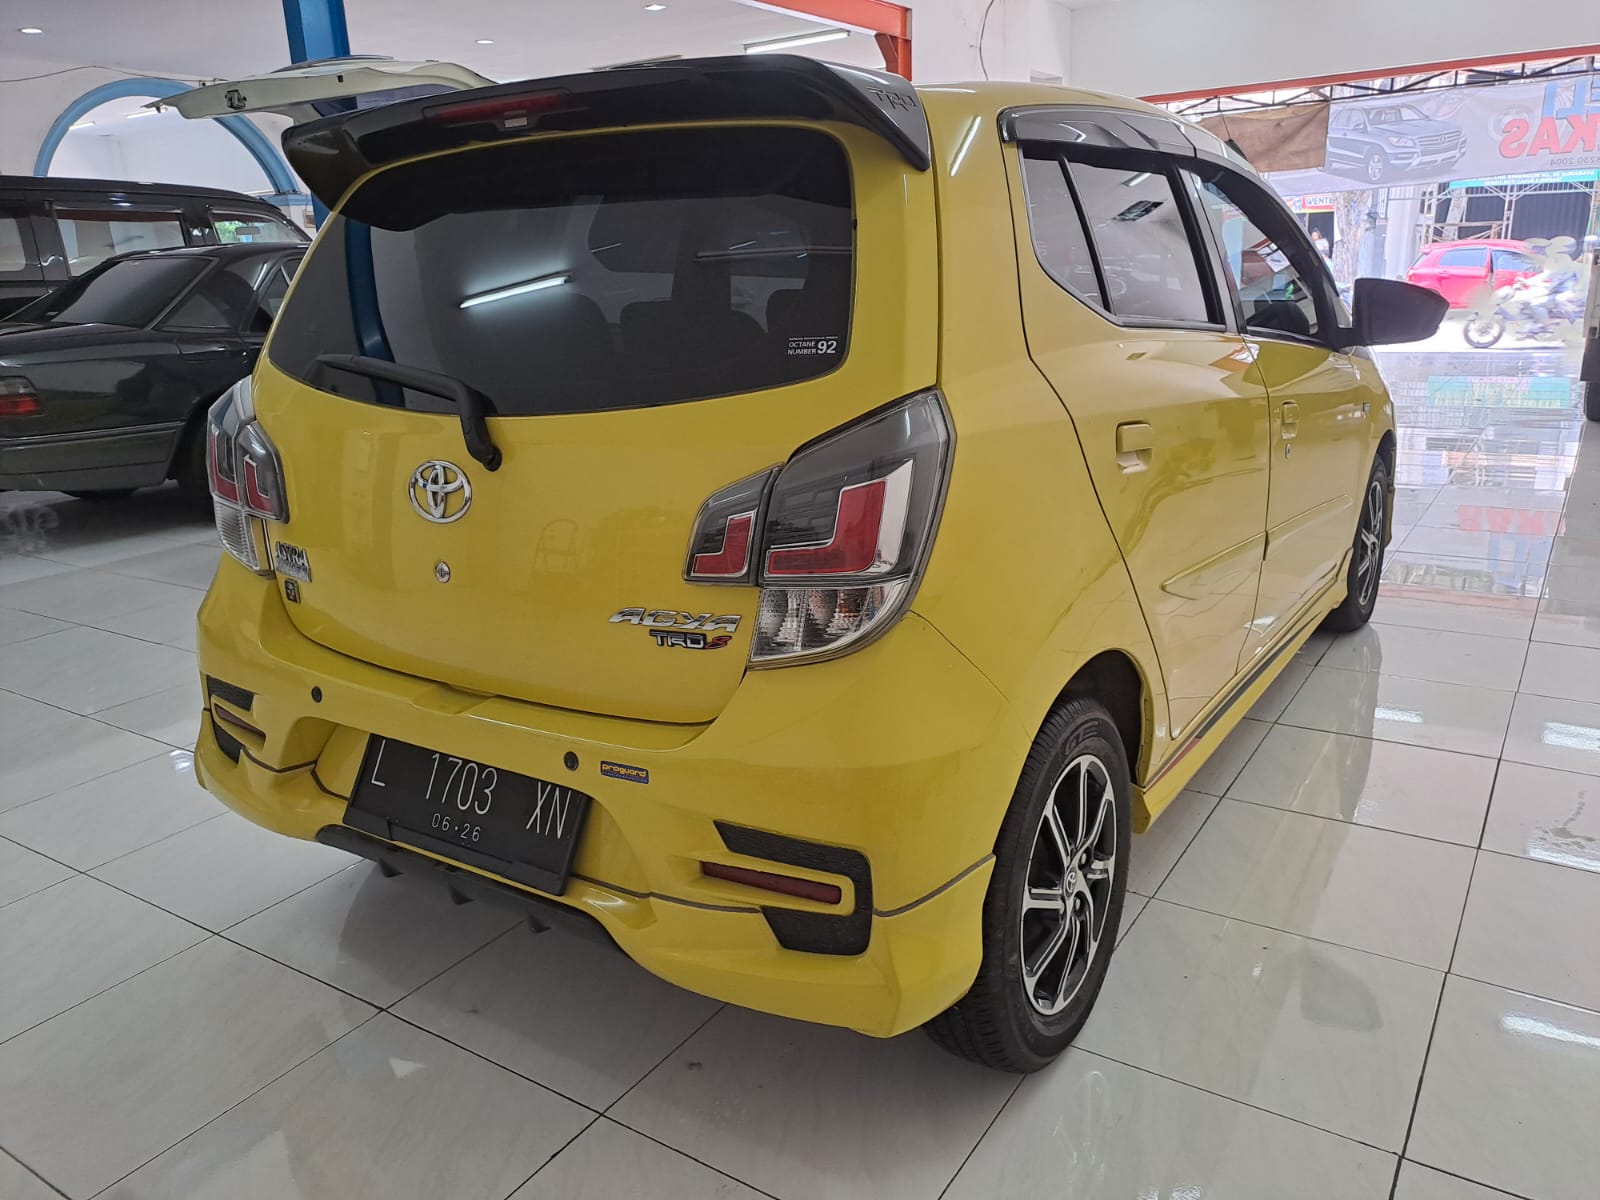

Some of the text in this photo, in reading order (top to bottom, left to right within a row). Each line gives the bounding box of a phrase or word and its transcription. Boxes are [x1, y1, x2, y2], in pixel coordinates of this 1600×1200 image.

[787, 348, 817, 356] NUMBER
[788, 340, 837, 354] OCTANE 92
[608, 607, 742, 632] AGYA
[601, 763, 647, 778] proguard
[370, 739, 572, 839] L 1703 XN
